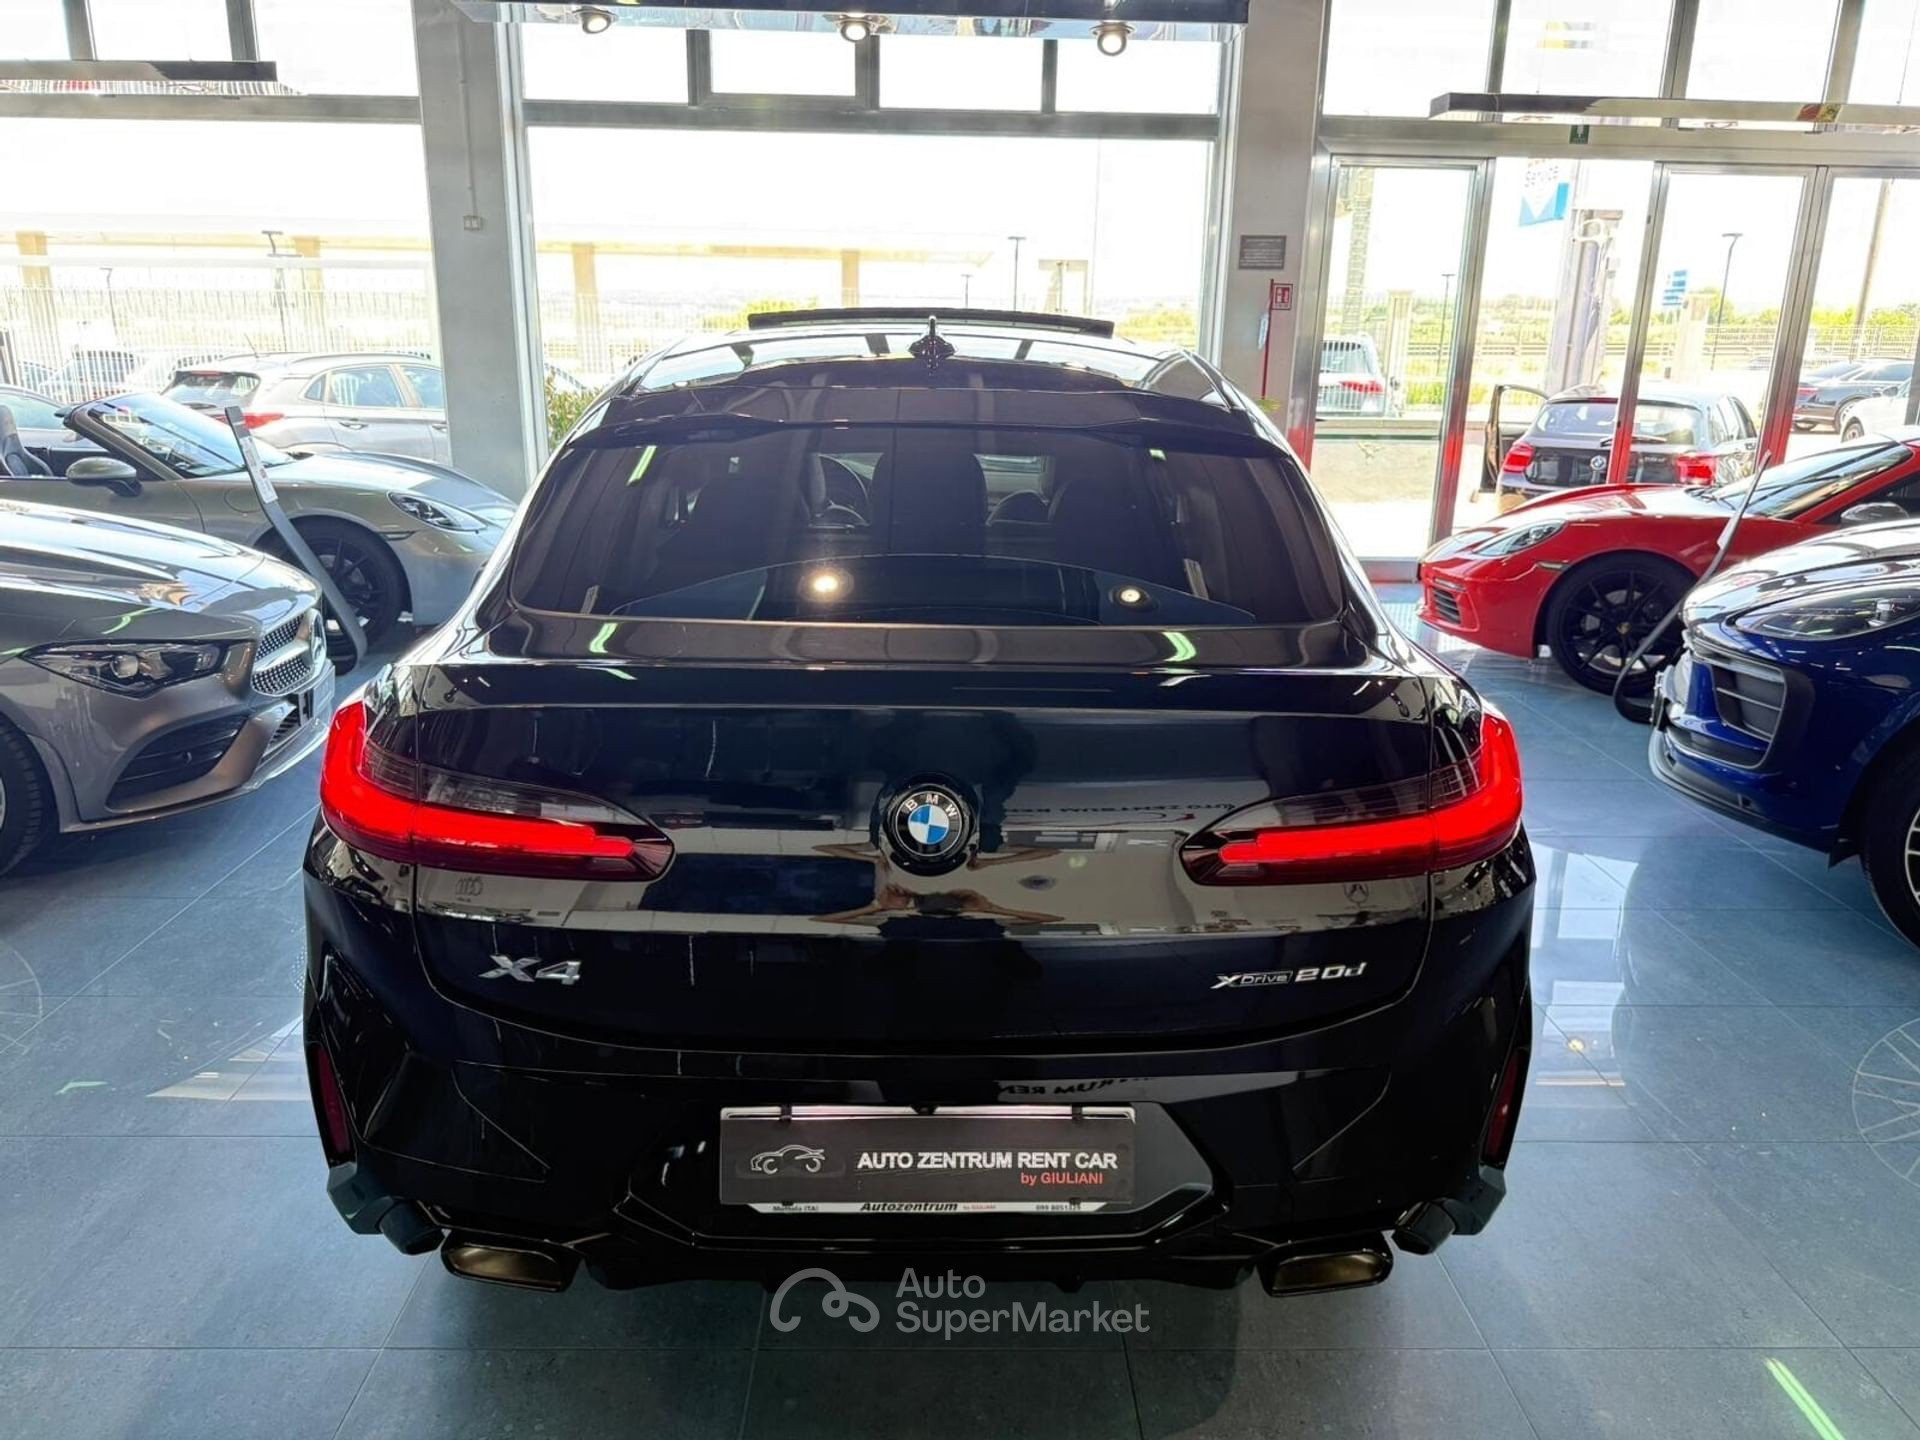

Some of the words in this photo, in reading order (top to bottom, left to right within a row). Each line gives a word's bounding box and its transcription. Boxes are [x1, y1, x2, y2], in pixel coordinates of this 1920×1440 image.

[905, 793, 958, 818] BMW
[478, 955, 581, 985] X4
[857, 1152, 914, 1169] AUTO
[916, 1152, 1013, 1169] ZENTRUM
[1017, 1152, 1071, 1169] RENT
[1074, 1152, 1119, 1169] CAR
[1020, 1172, 1037, 1186] by
[1040, 1172, 1104, 1185] GIULIANI
[860, 1202, 958, 1212] Autozentrum
